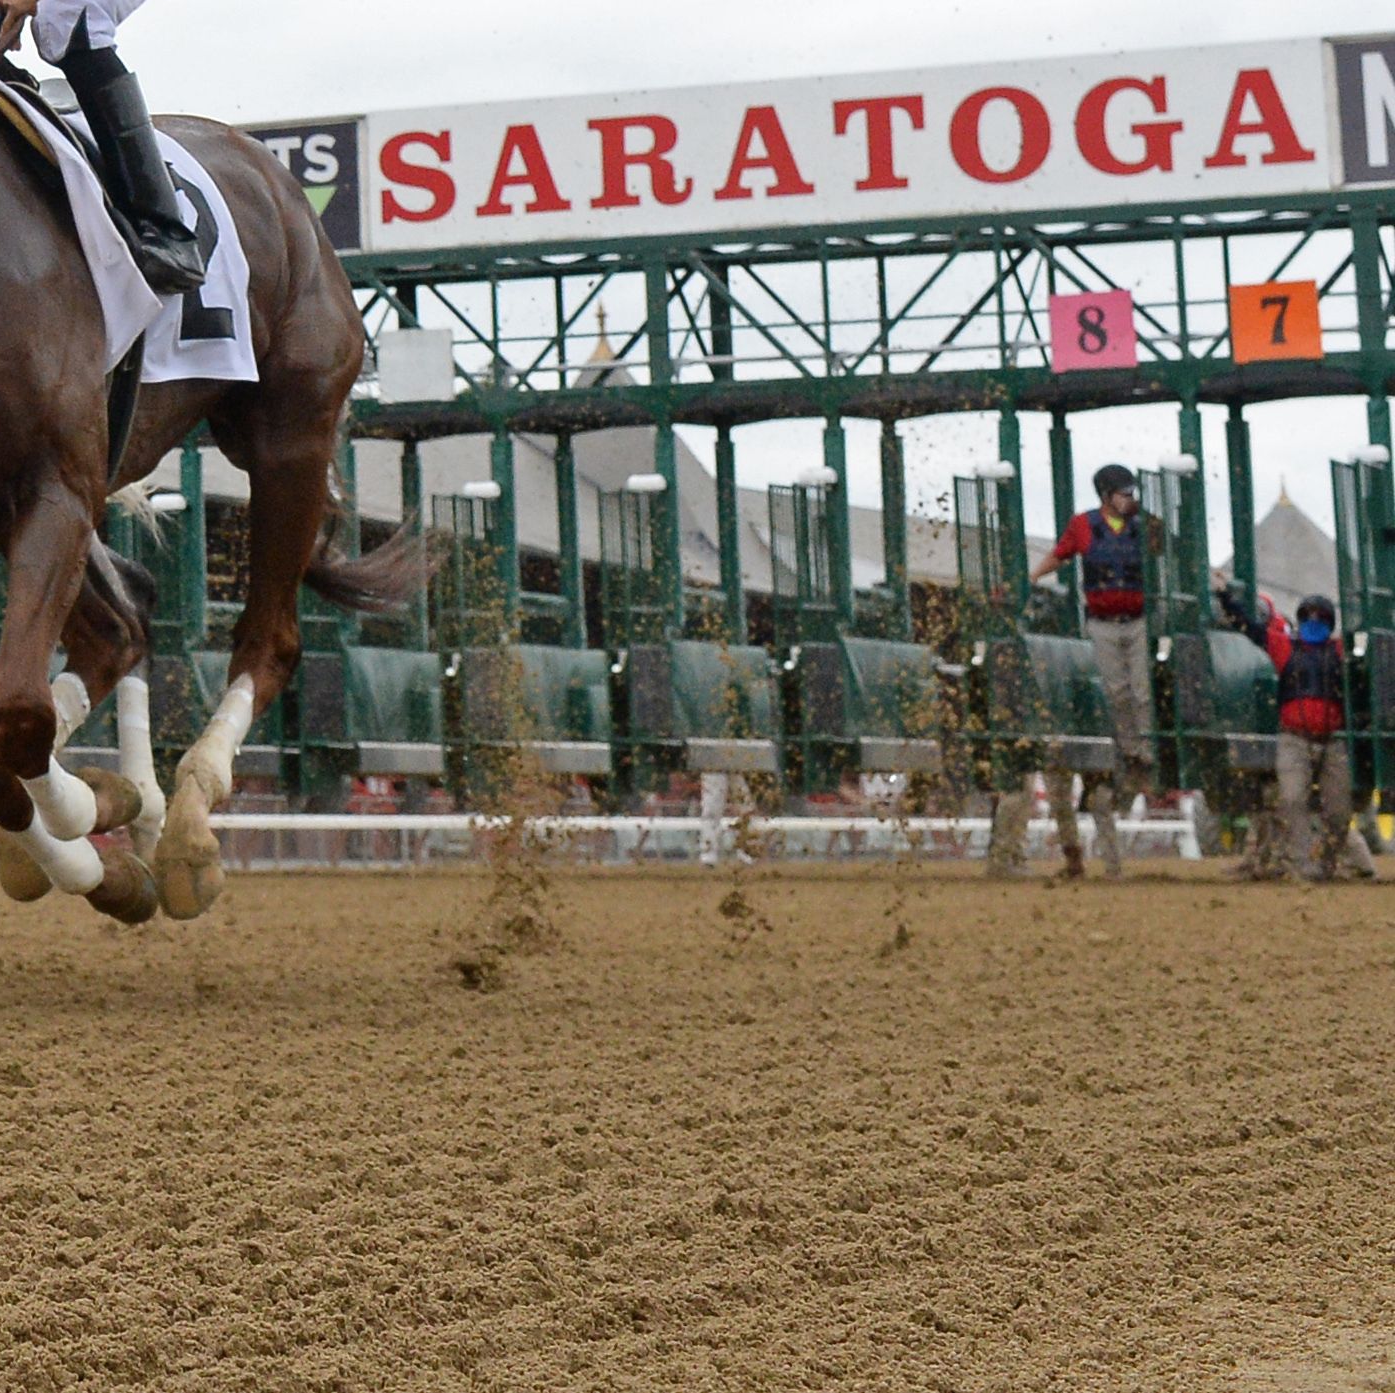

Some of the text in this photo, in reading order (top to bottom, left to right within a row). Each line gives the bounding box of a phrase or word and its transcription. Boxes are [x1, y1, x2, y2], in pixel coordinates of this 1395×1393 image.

[378, 67, 1317, 226] SARATOGA
[163, 160, 237, 341] 2
[1077, 305, 1108, 355] 8
[1260, 295, 1290, 345] 7
